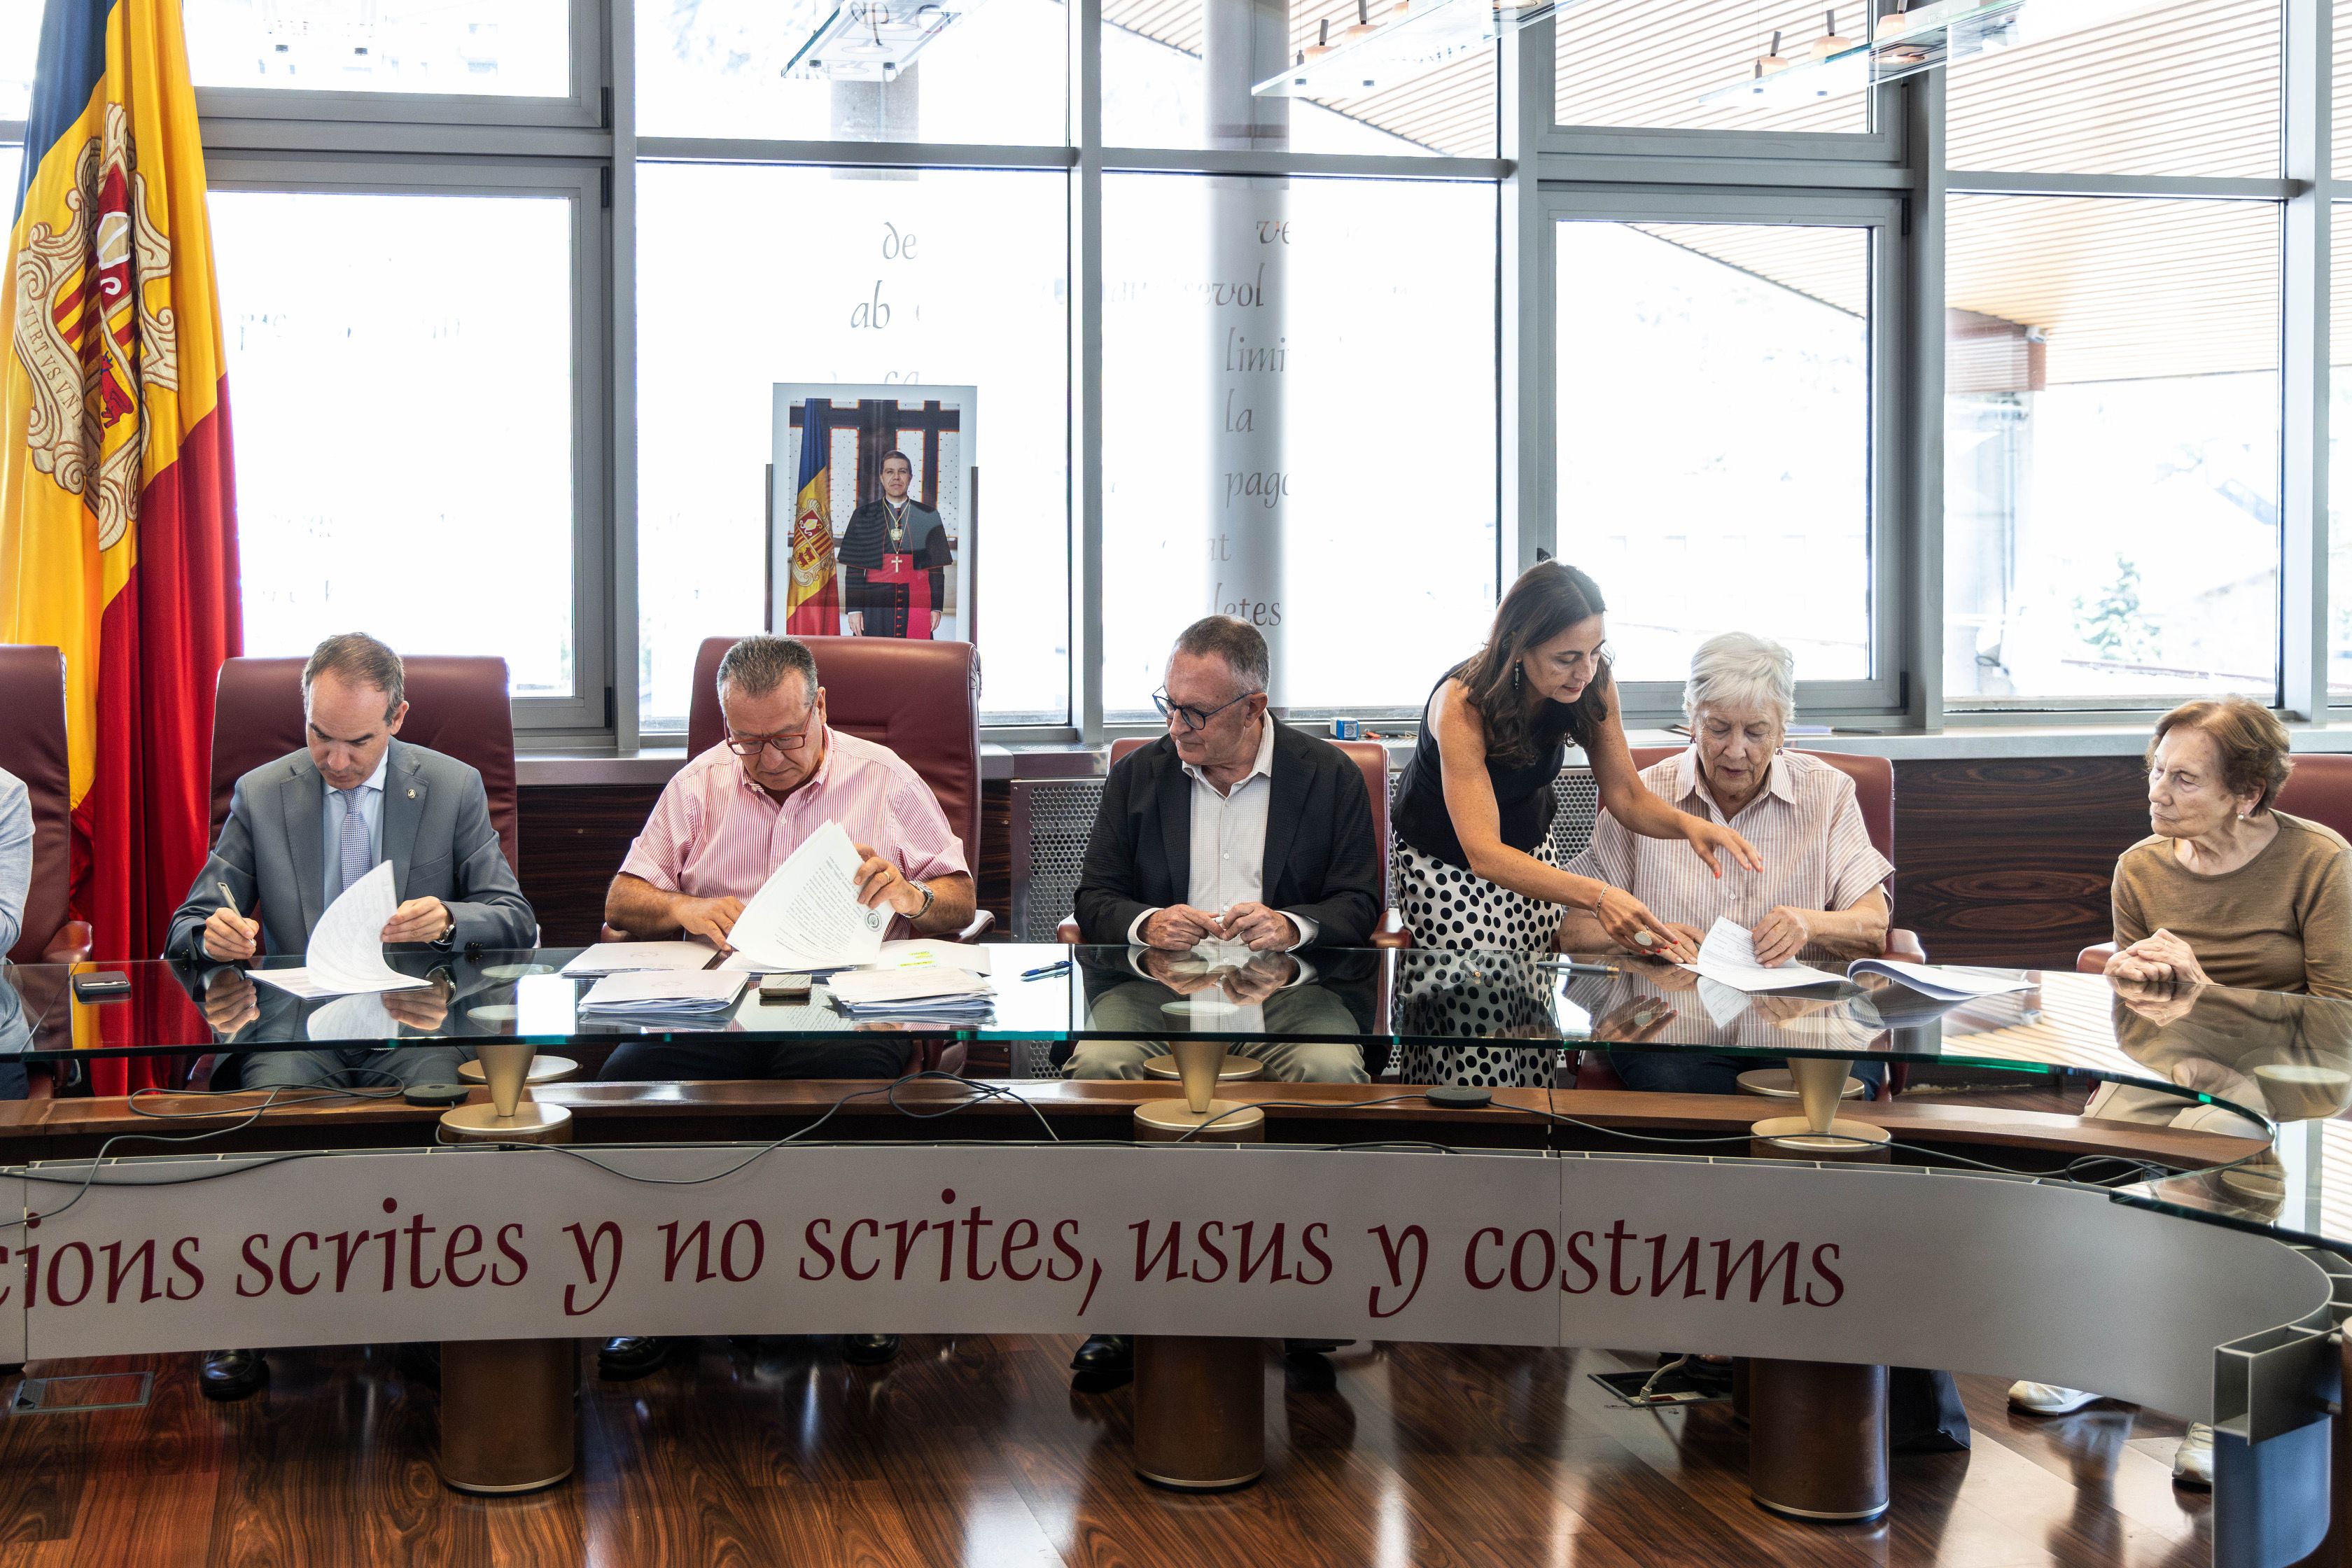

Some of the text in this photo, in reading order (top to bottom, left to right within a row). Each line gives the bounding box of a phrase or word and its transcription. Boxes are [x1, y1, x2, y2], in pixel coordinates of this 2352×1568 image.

[882, 221, 918, 260] de
[850, 279, 890, 329] ab
[1226, 388, 1254, 433] la
[0, 1212, 204, 1309] ions
[236, 1197, 528, 1297] scrites
[657, 1218, 765, 1283] no
[798, 1187, 1102, 1316] scrites,
[1128, 1219, 1333, 1285] usus
[1464, 1219, 1844, 1307] costums
